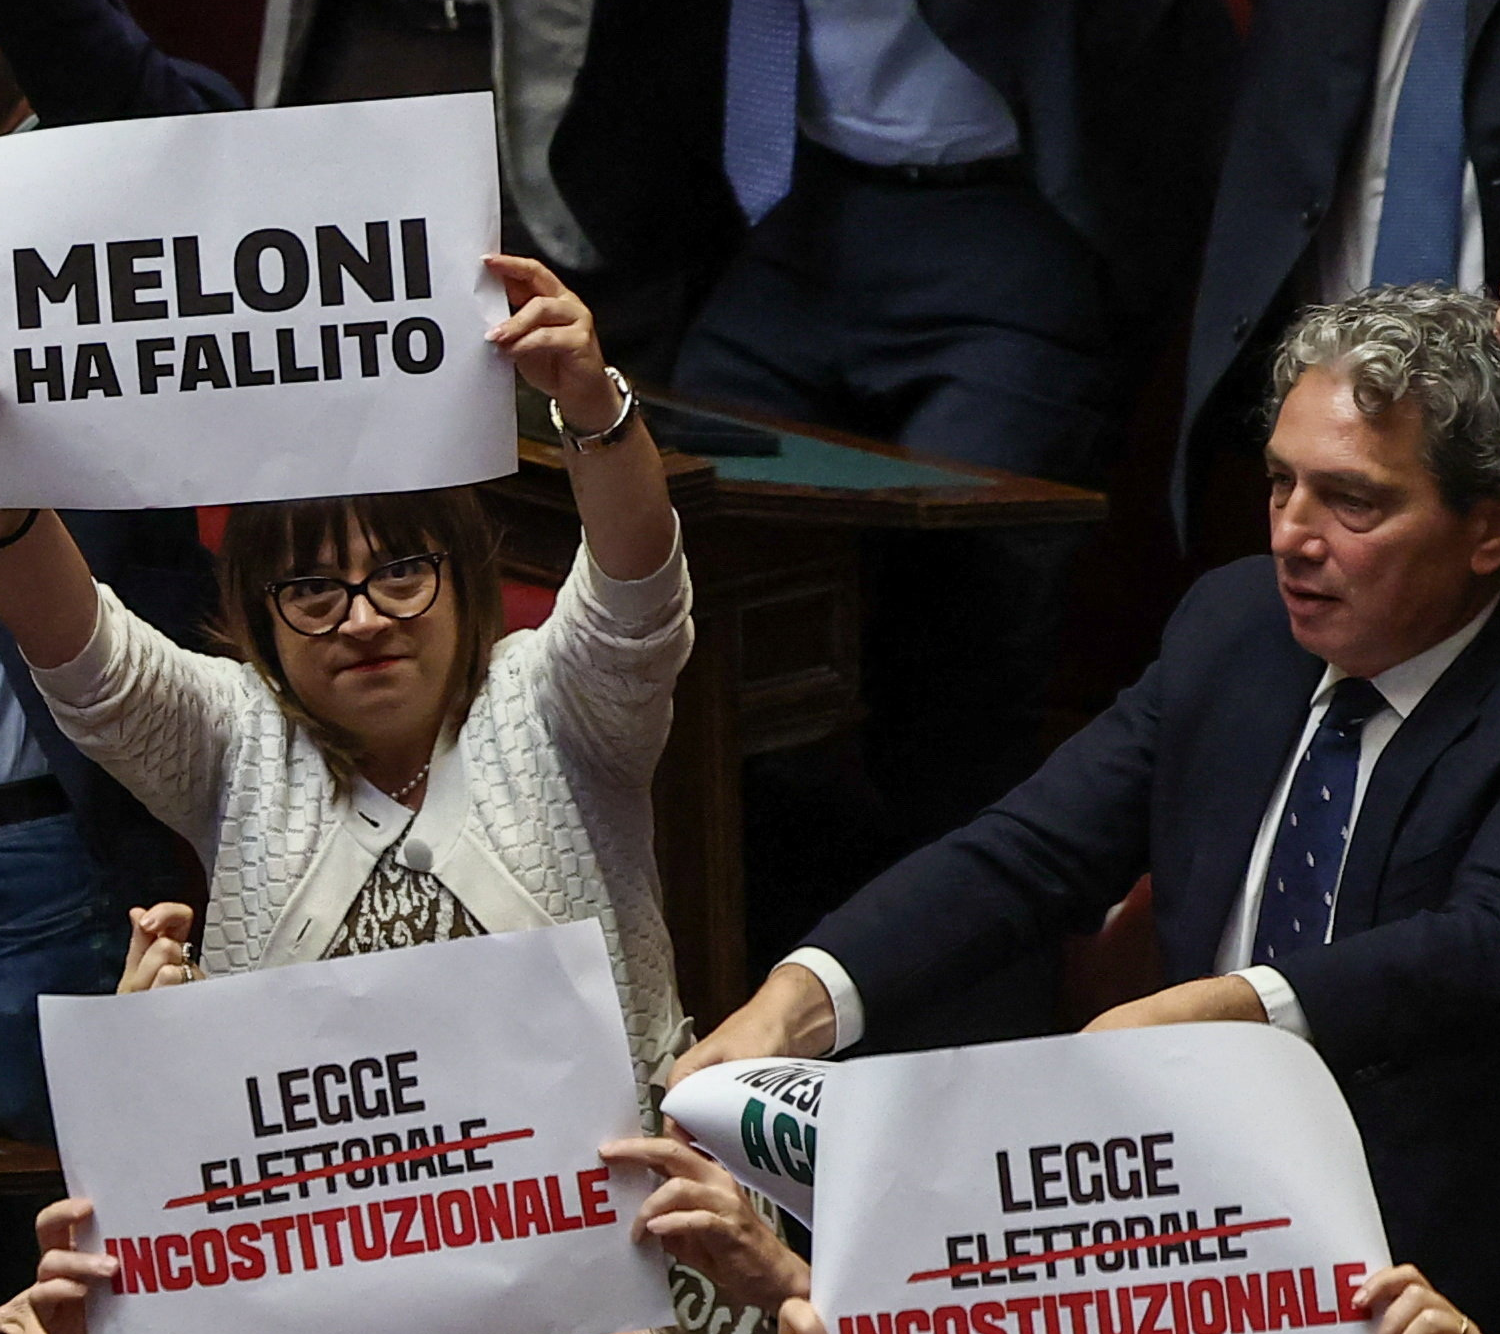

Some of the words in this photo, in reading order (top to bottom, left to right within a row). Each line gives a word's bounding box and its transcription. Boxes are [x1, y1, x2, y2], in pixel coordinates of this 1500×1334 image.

[12, 217, 434, 331] MELONI
[14, 343, 122, 405] HA
[138, 316, 446, 394] FALLITO
[246, 1050, 425, 1138] LEGGE
[200, 1118, 494, 1215] ELETTORALE
[996, 1131, 1178, 1216] LEGGE
[105, 1167, 617, 1295] INCOSTITUZIONALE
[945, 1206, 1248, 1291] ELETTORALE
